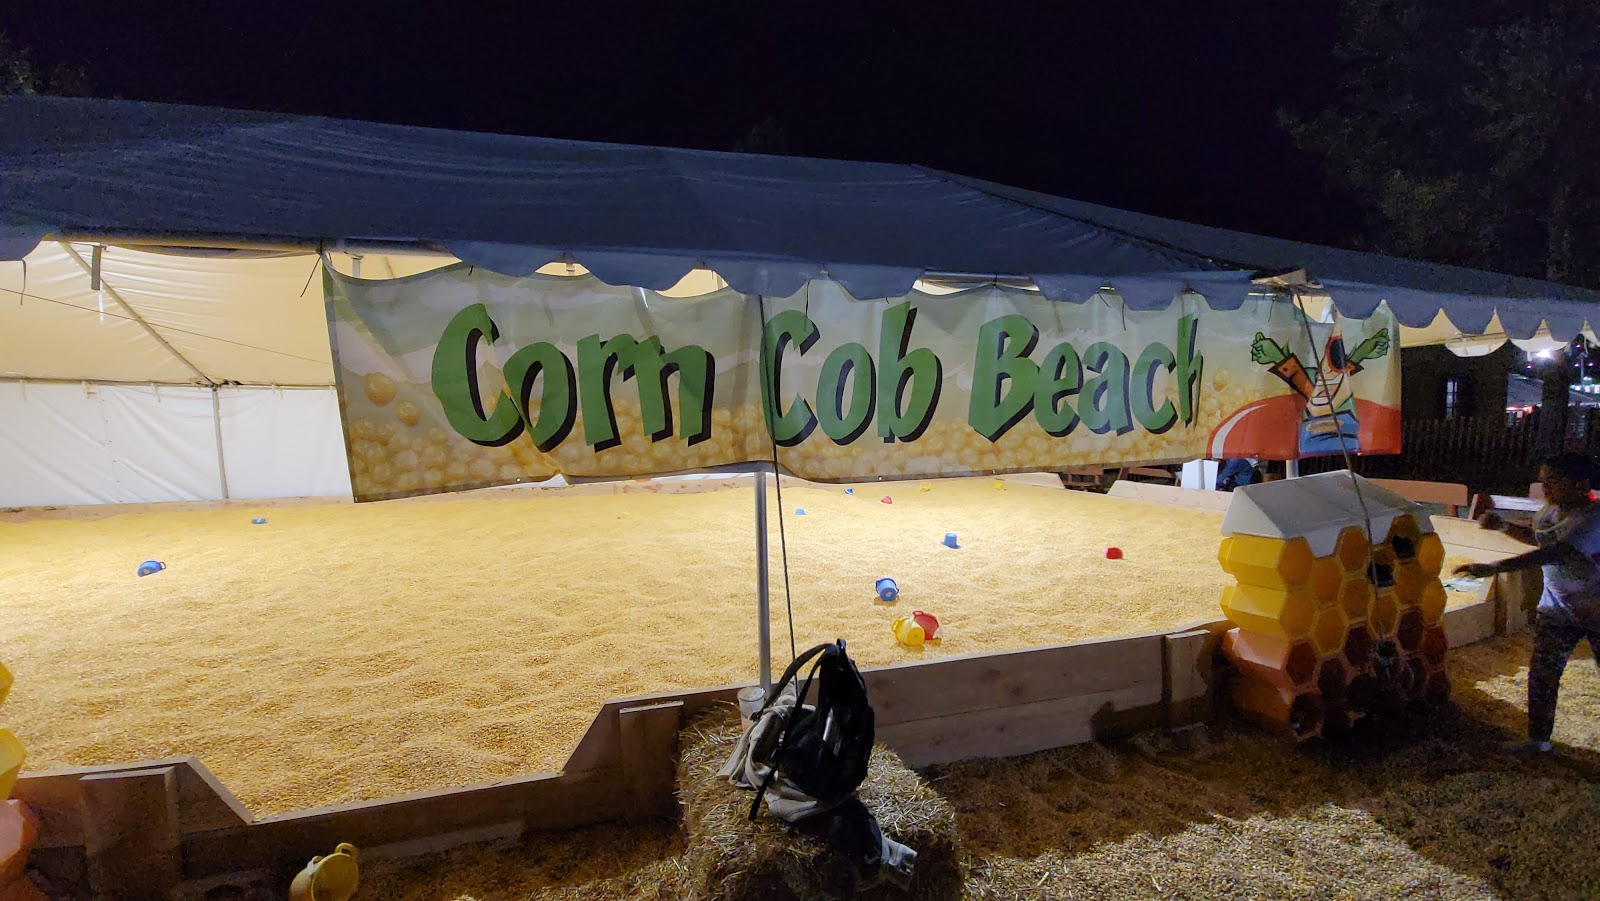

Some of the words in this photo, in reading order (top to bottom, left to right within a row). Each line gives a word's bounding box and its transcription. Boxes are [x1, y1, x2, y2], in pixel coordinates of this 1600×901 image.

[432, 303, 716, 453] Corn
[760, 301, 943, 447] Cob
[967, 313, 1204, 443] Beach
